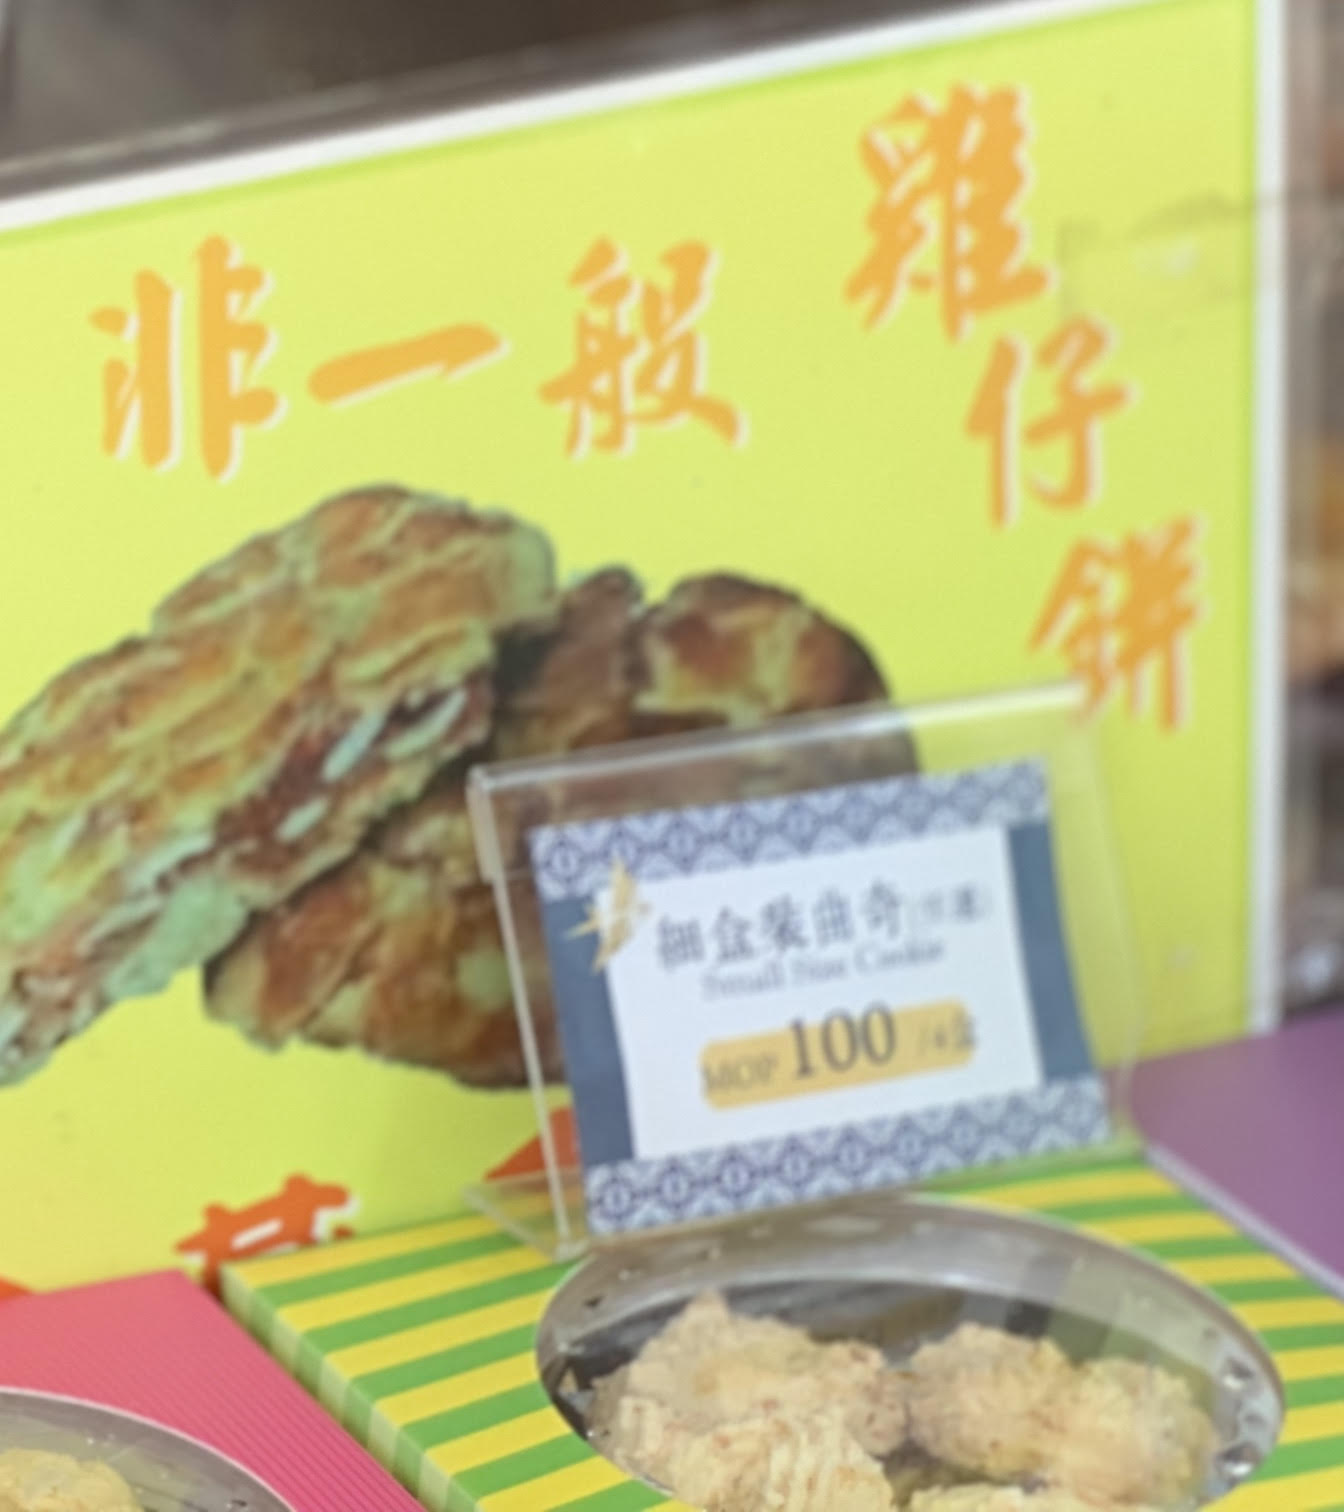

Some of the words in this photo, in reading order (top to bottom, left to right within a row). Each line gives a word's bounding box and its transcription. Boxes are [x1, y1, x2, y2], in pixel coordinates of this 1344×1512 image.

[87, 234, 748, 482] 非一般
[789, 1001, 897, 1078] 100
